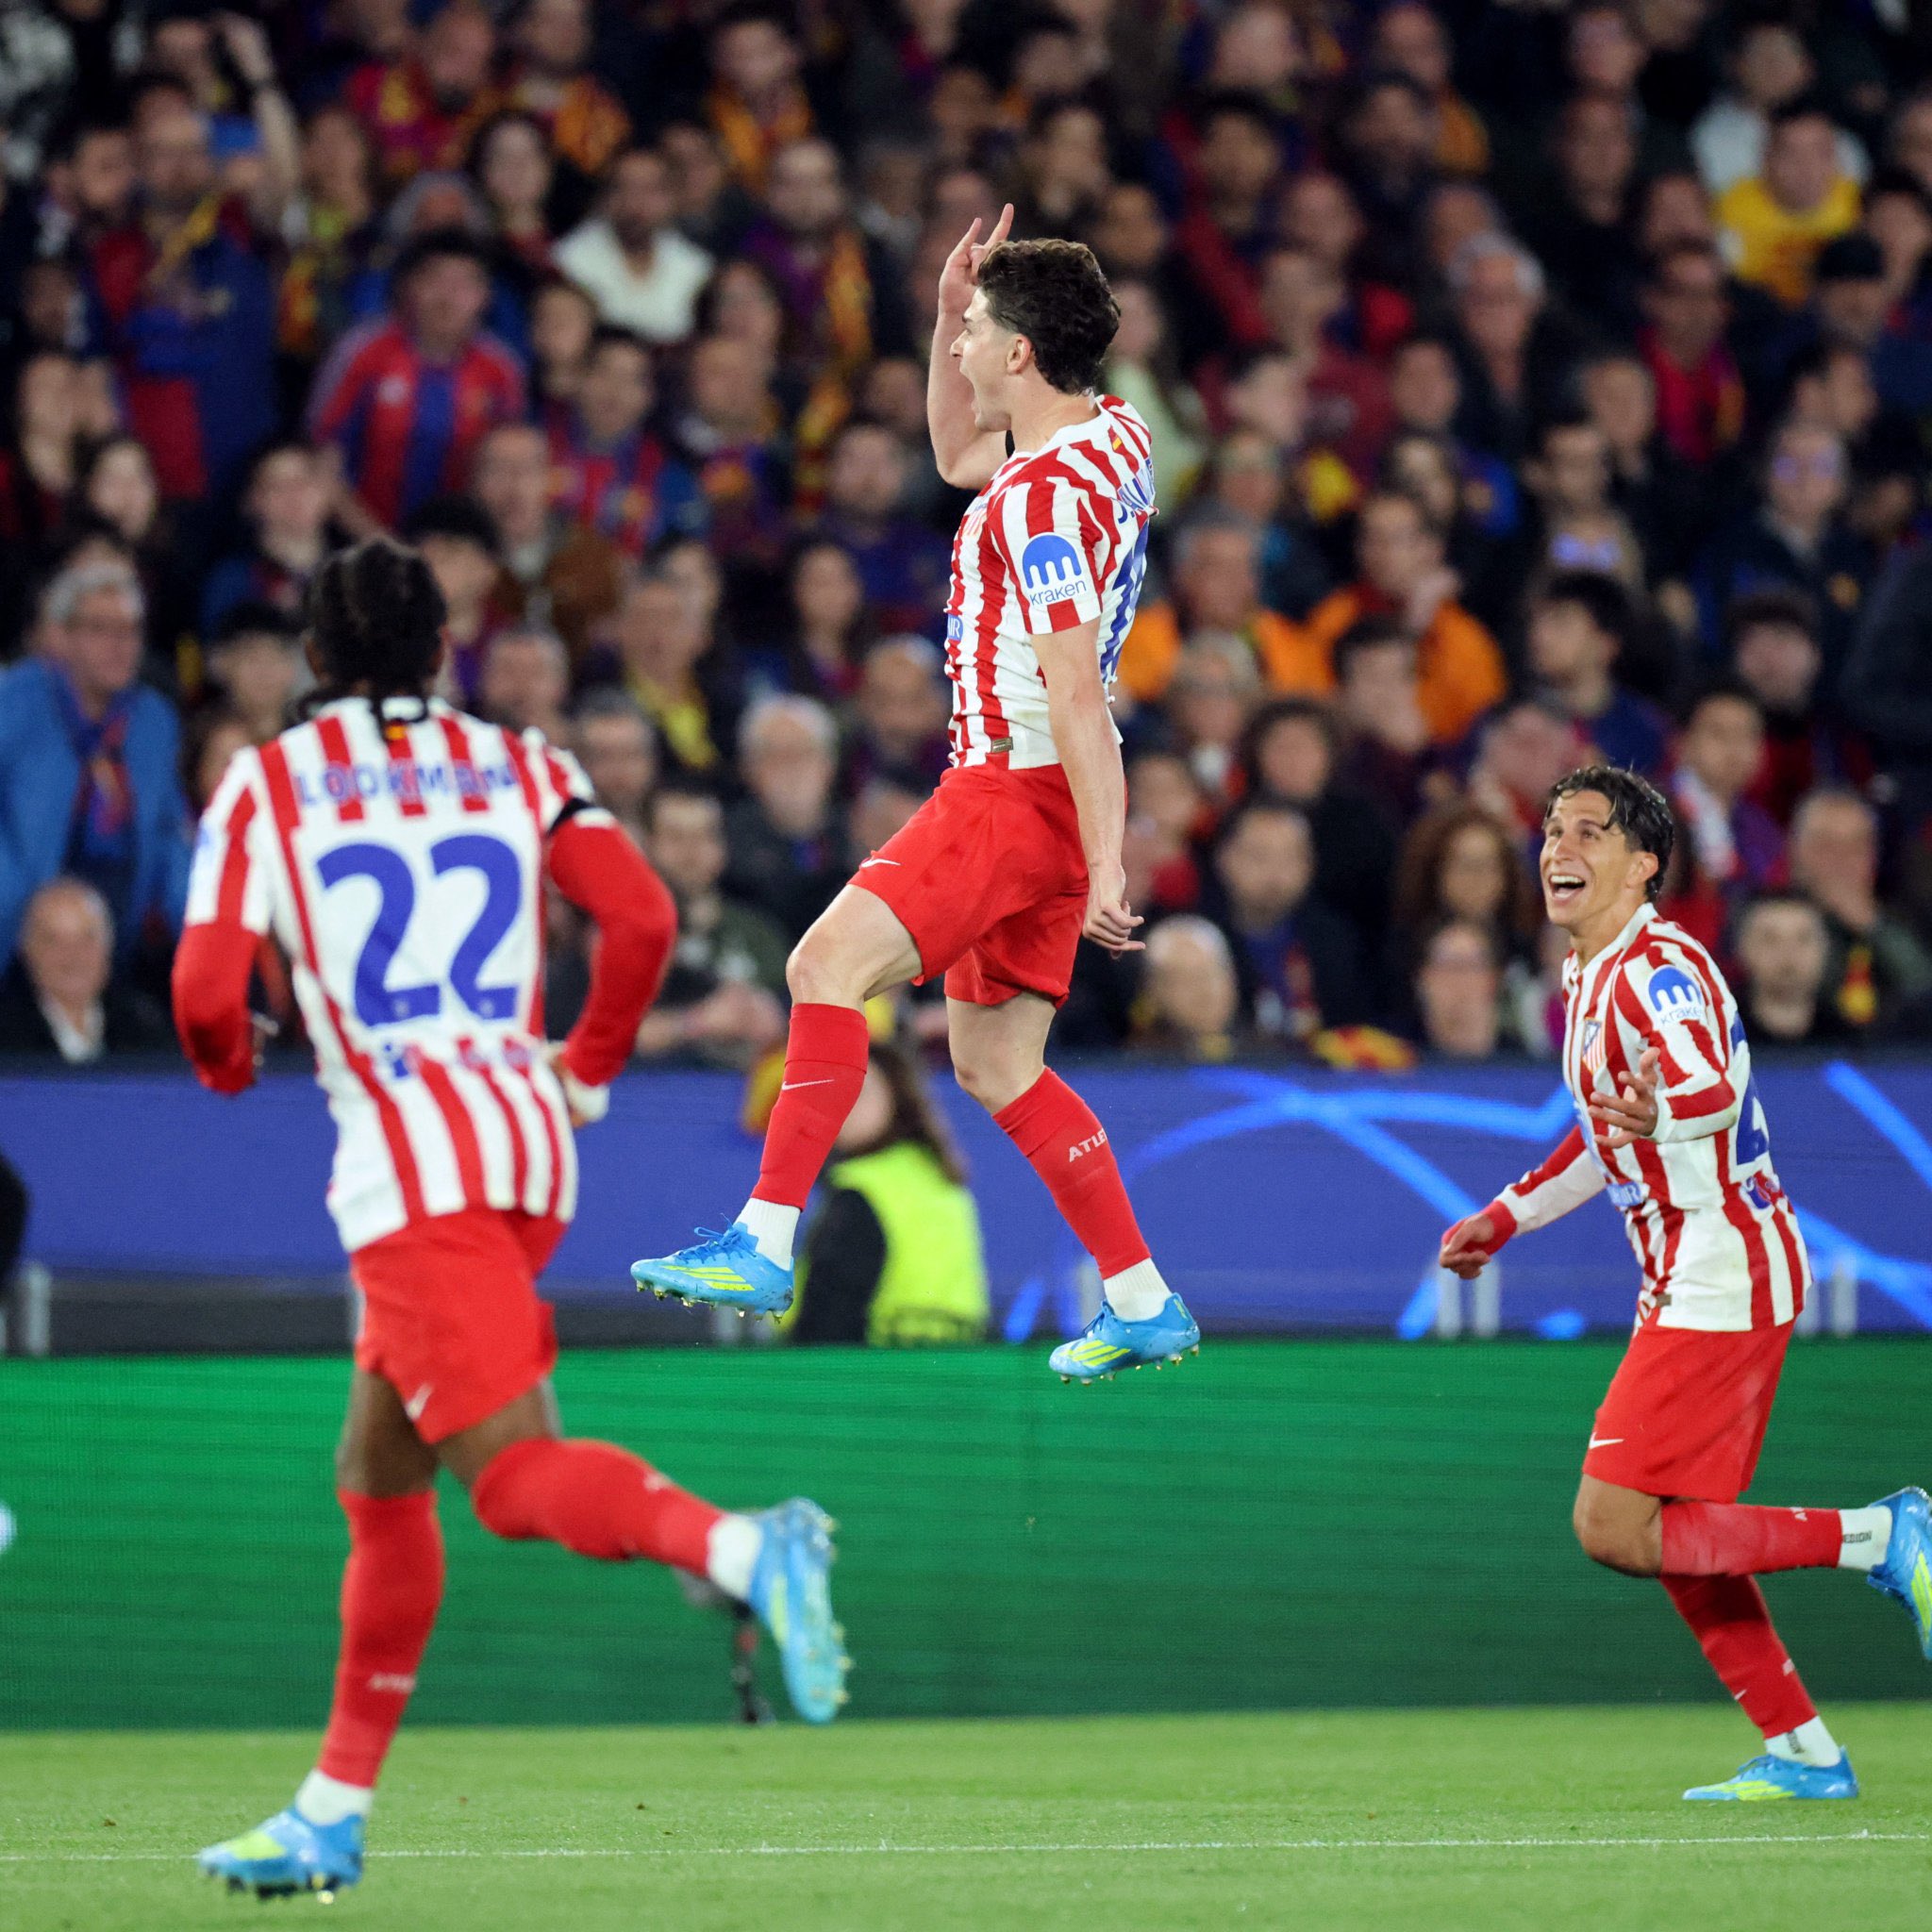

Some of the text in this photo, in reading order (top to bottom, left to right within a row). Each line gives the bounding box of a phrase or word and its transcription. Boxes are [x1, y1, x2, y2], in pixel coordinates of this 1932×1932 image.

[1029, 579, 1087, 606] kraken
[295, 758, 517, 807] LOOKMAN
[317, 834, 523, 1027] 22
